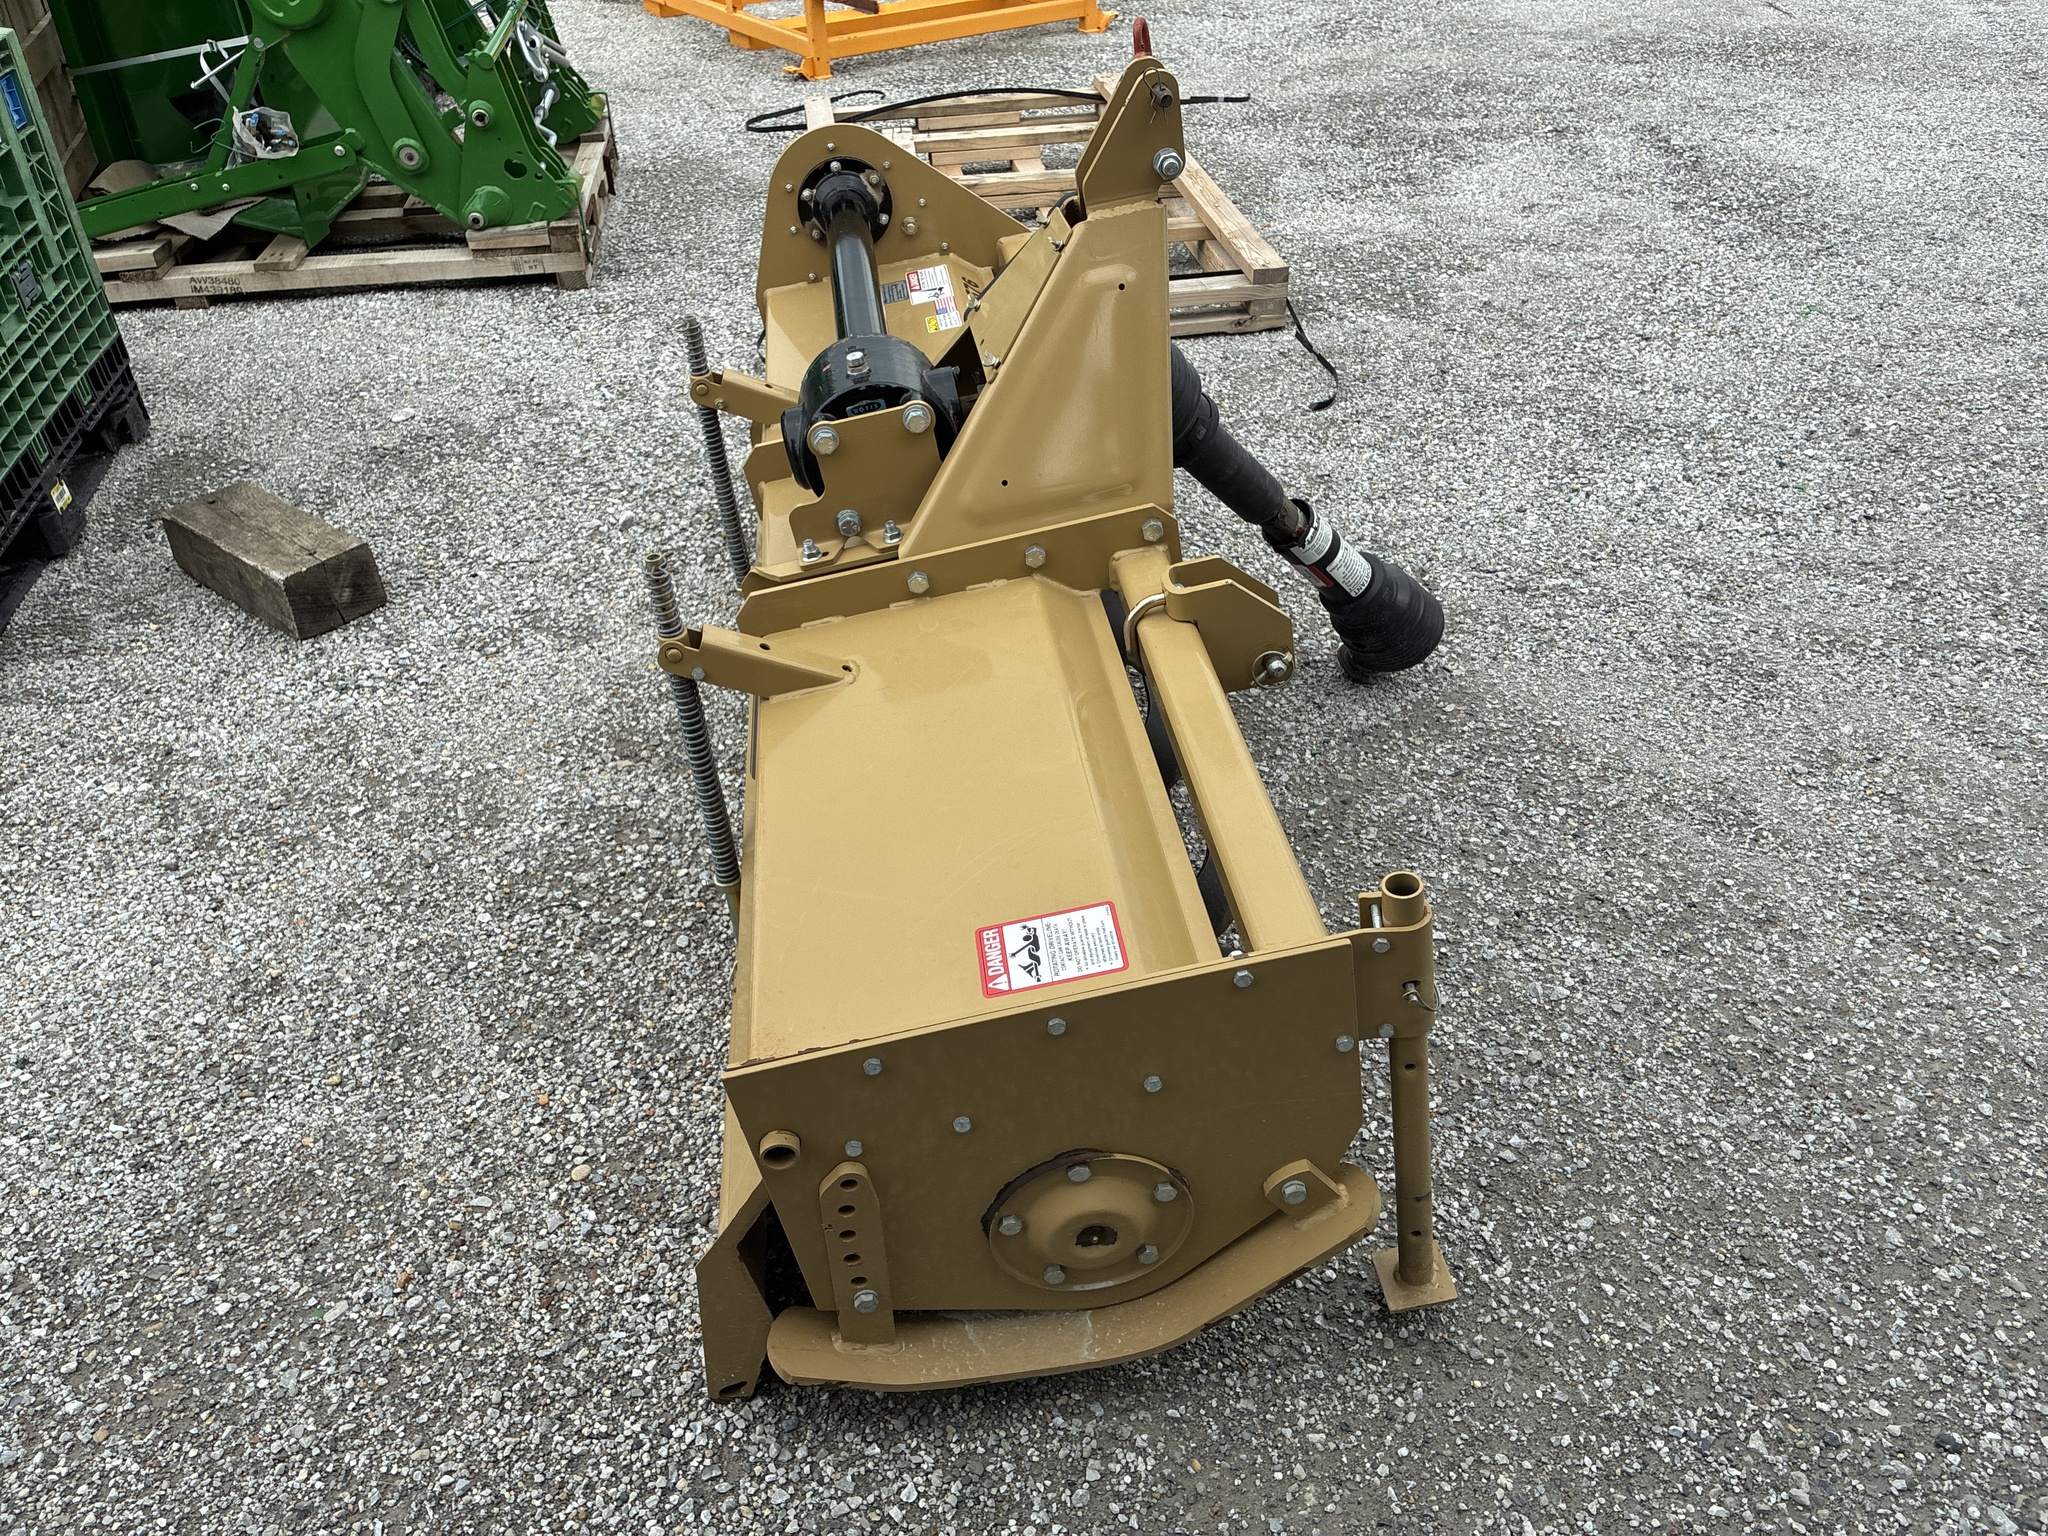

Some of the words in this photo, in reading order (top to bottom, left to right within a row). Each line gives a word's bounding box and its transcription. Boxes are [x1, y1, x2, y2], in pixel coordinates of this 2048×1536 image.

[190, 276, 241, 286] AW38480
[983, 928, 1005, 976] DANGER
[1064, 945, 1073, 962] KEEP
[1070, 935, 1079, 956] OPERATE
[1049, 949, 1060, 977] ROTATING
[1058, 954, 1066, 971] CONTACT
